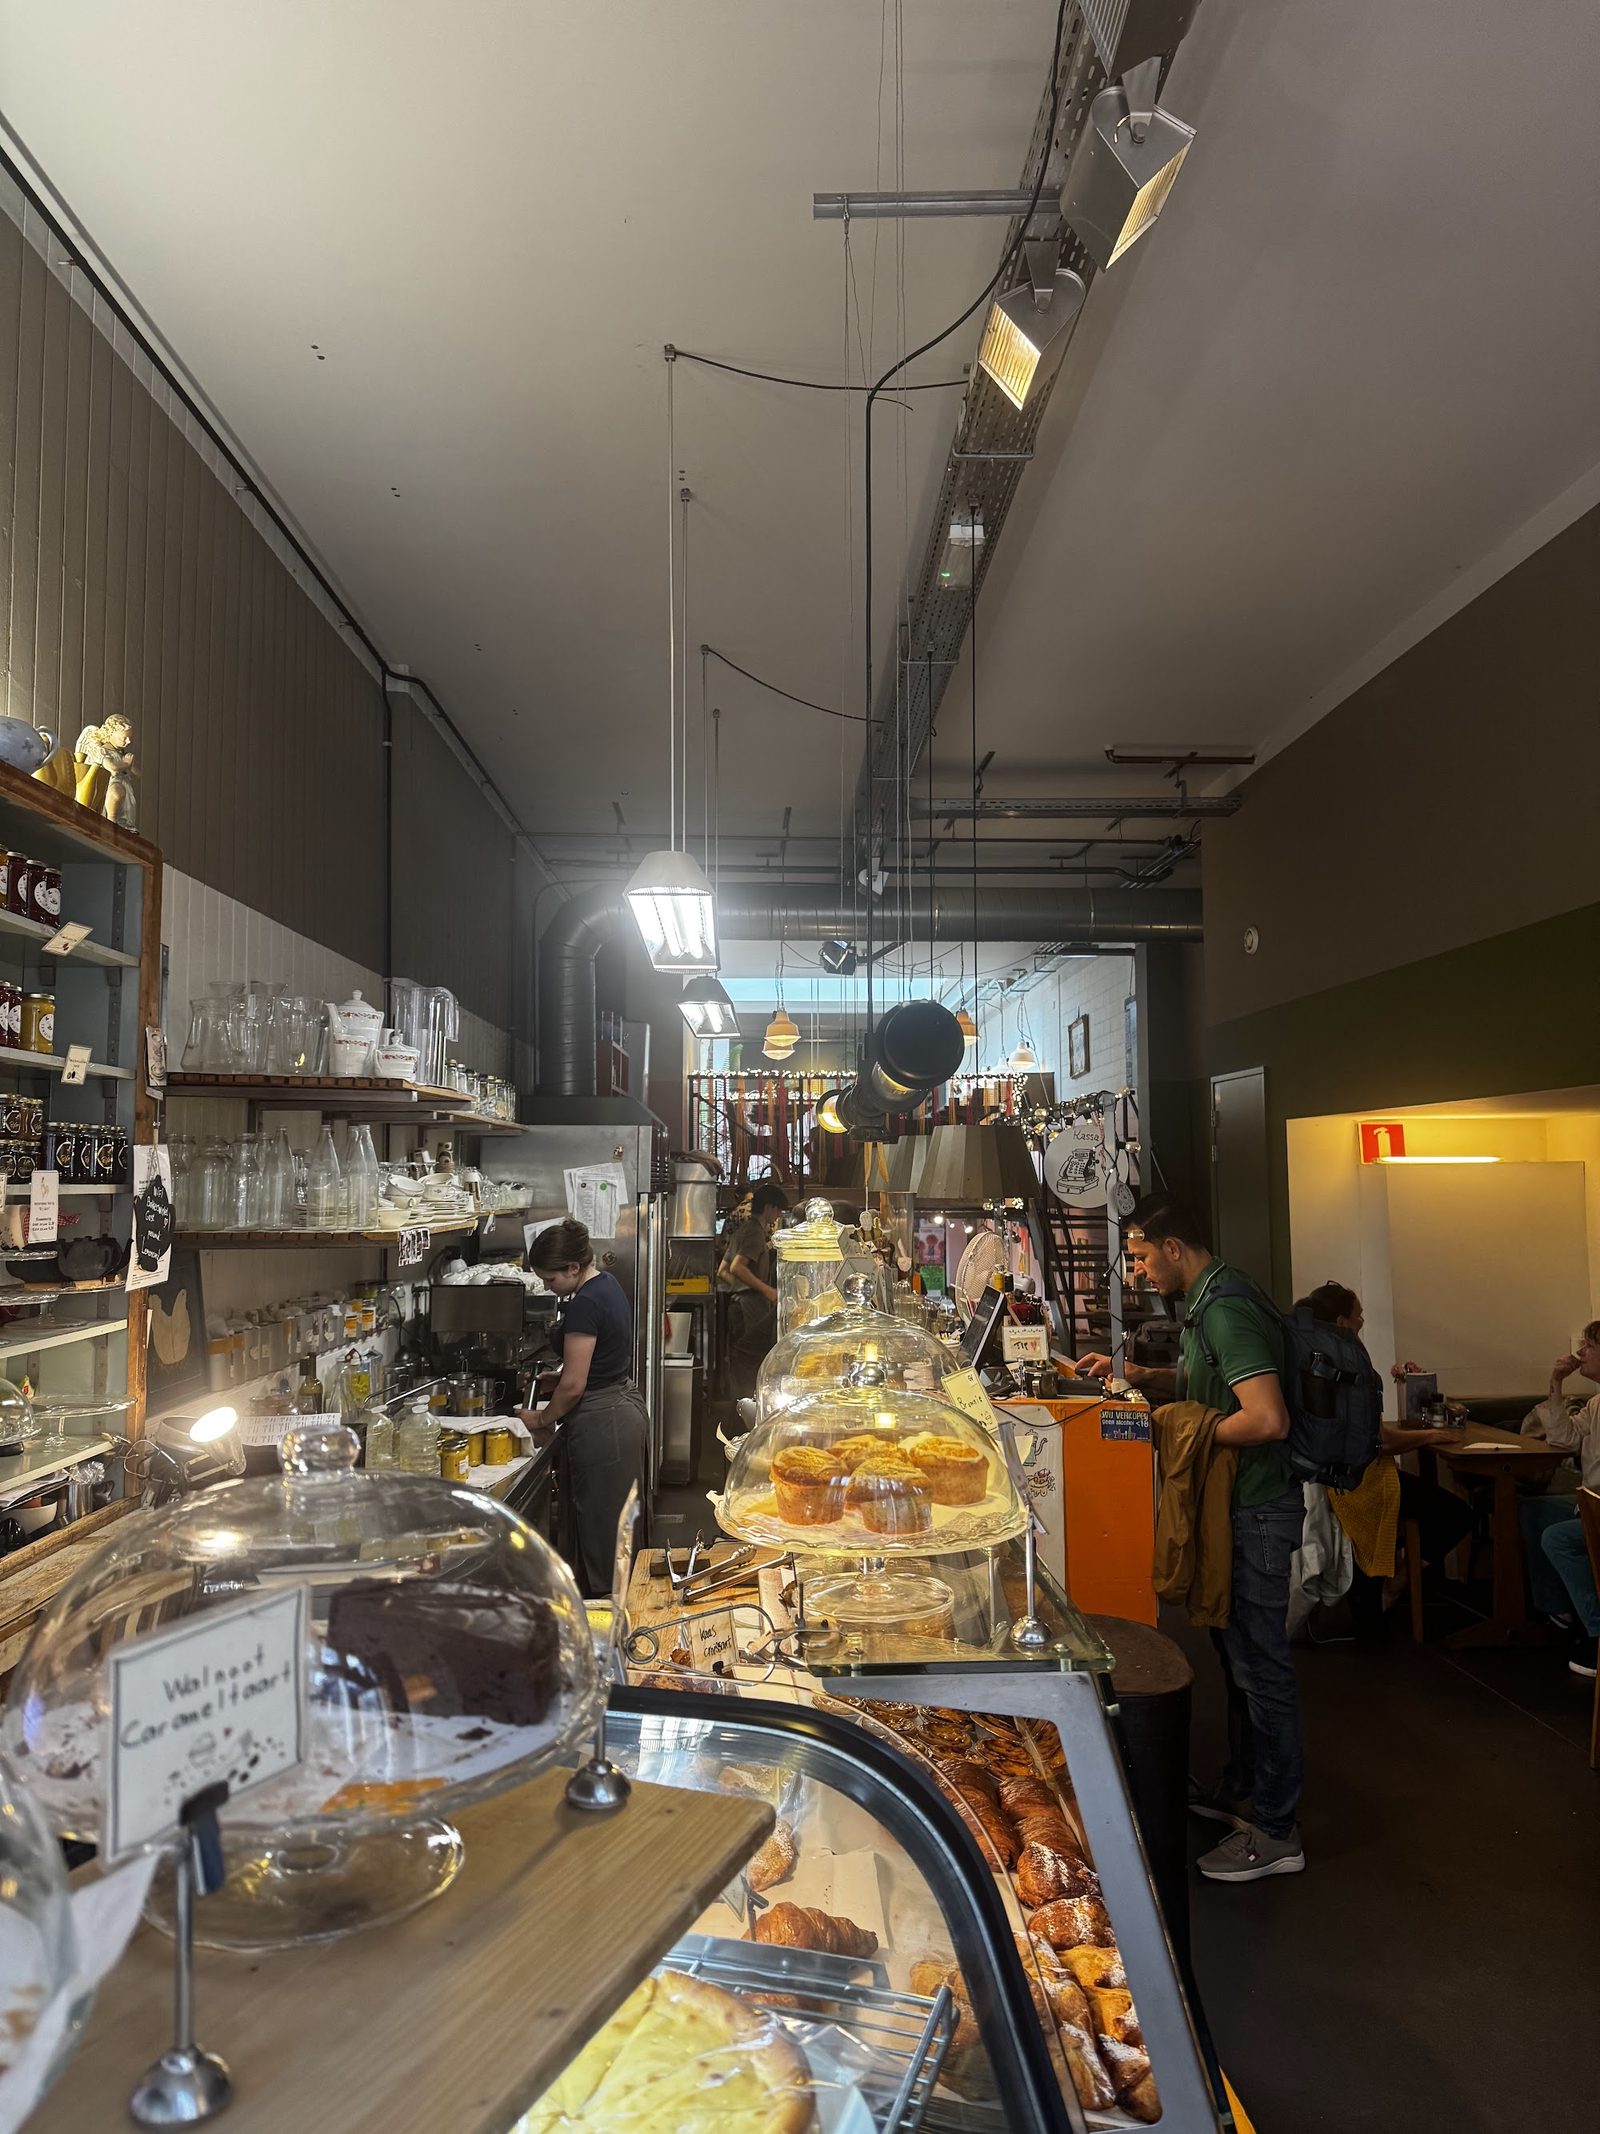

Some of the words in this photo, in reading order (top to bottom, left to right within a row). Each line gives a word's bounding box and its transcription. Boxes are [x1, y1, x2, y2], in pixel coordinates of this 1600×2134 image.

[1073, 1130, 1100, 1142] Kassa
[957, 1395, 983, 1410] Brownie
[1115, 1411, 1149, 1421] VERKOPEN
[162, 1643, 264, 1702] Walnoot
[120, 1660, 291, 1749] Carameltaart
